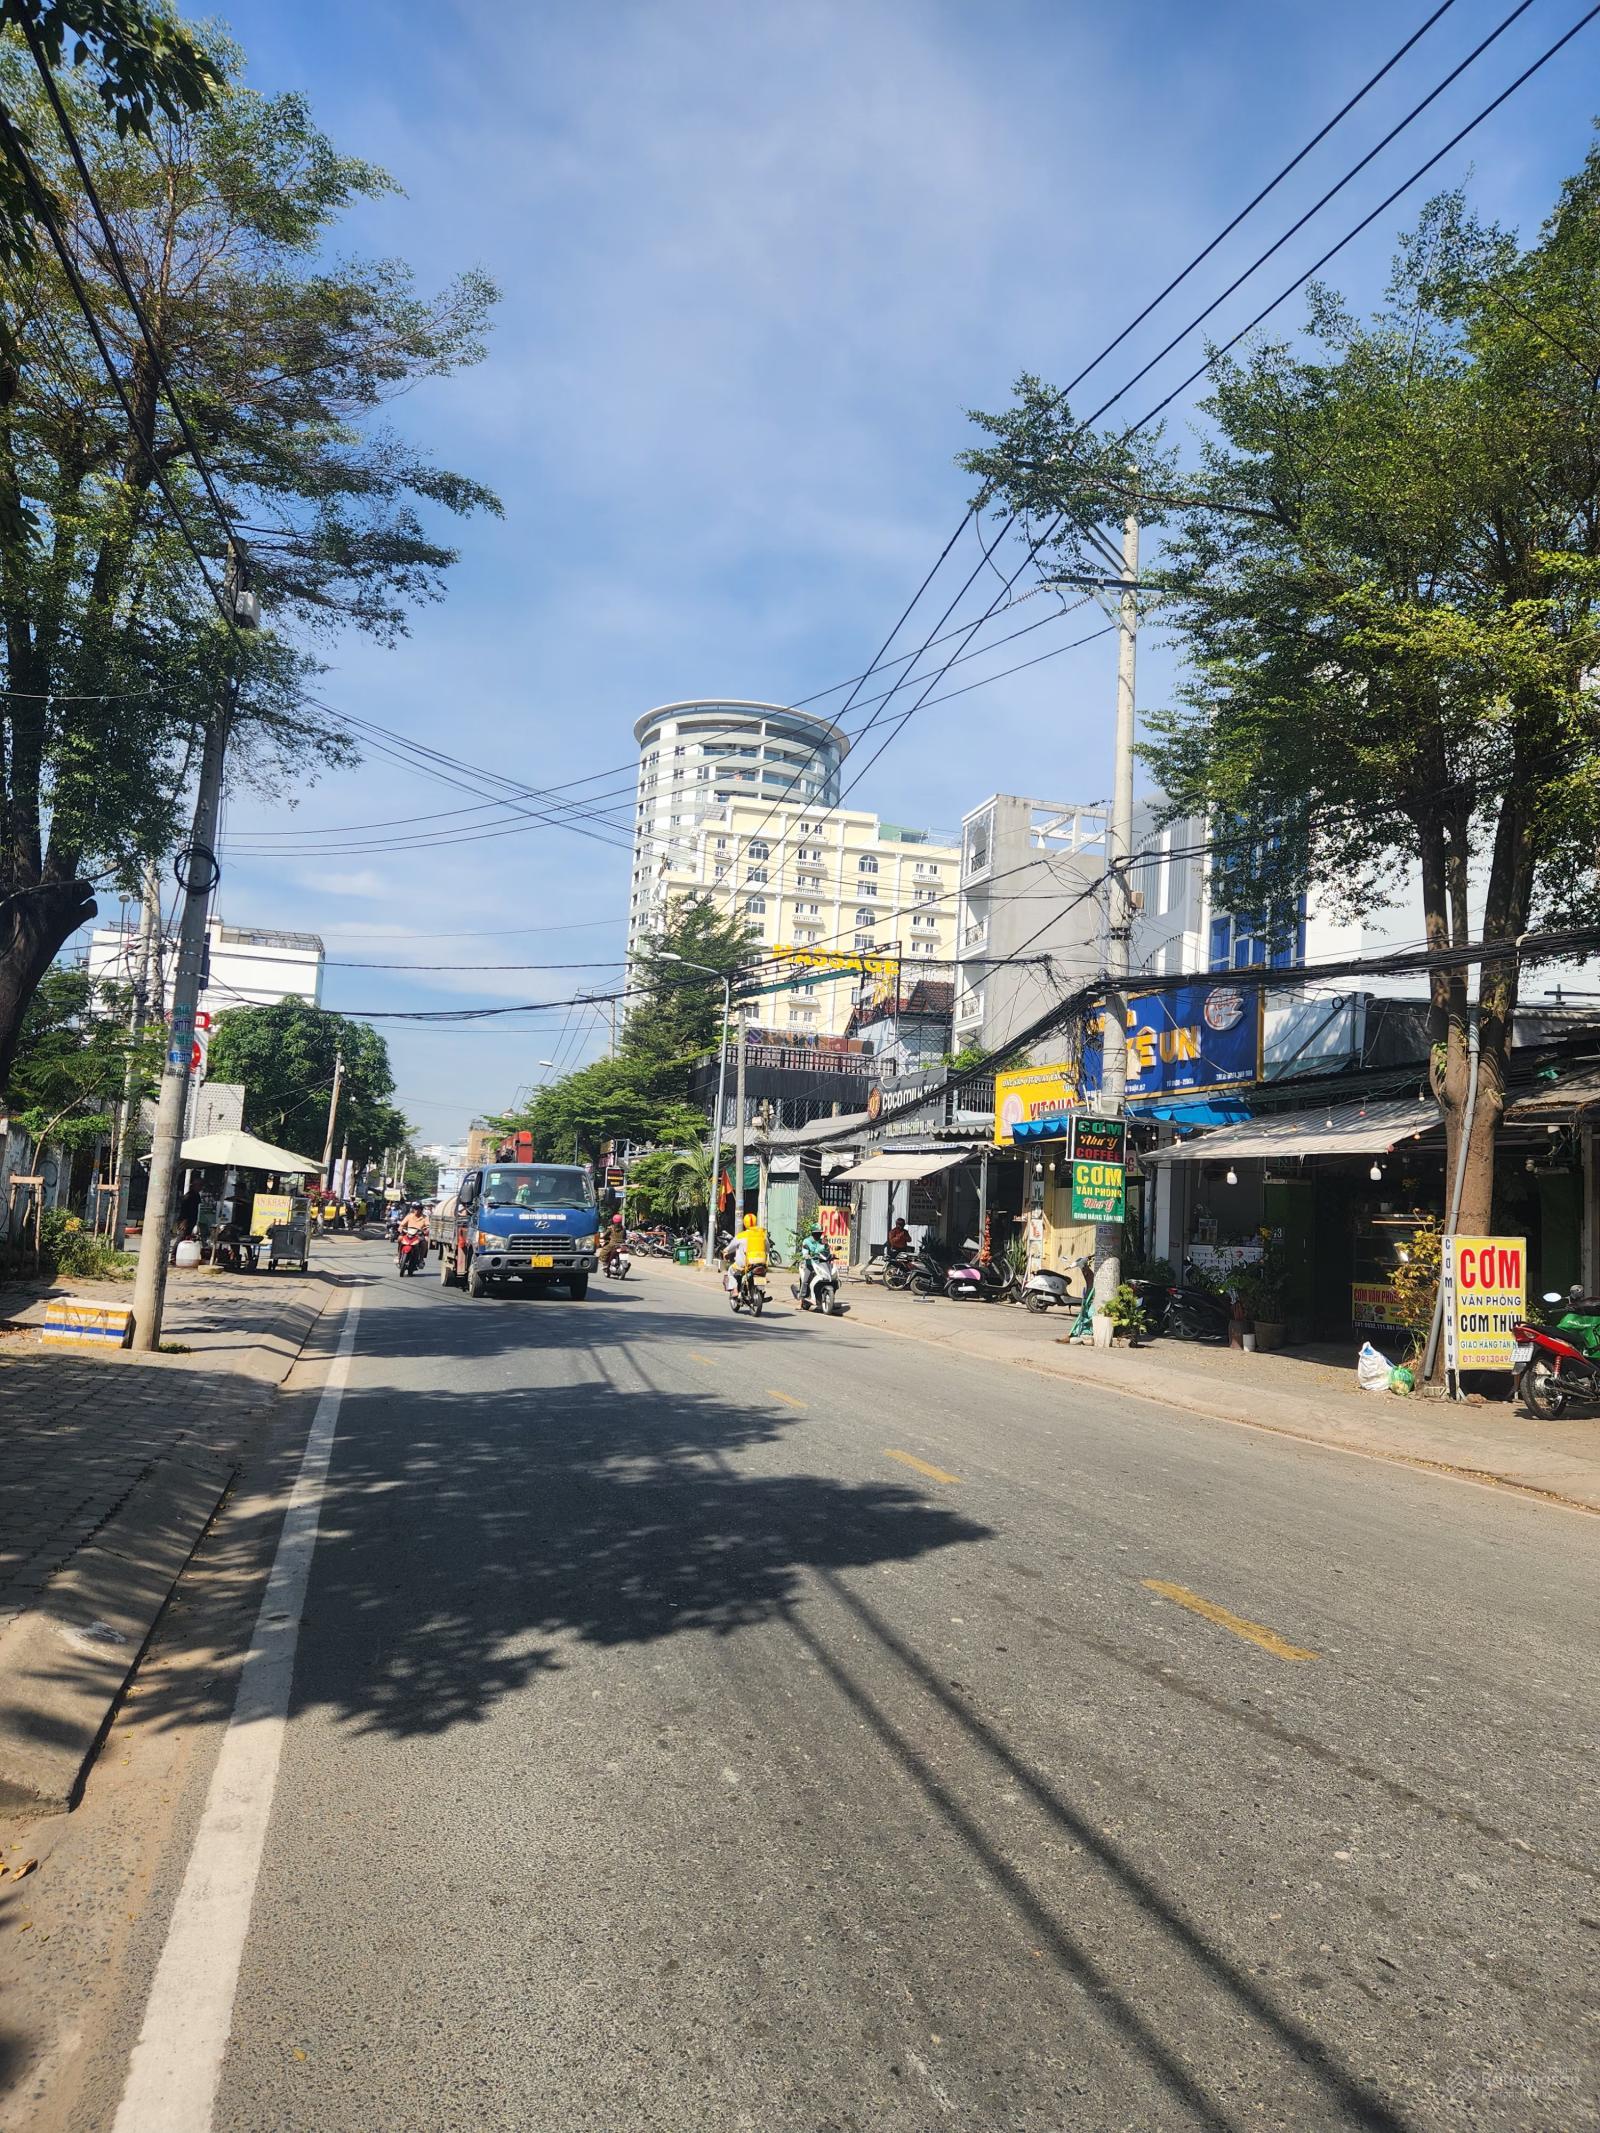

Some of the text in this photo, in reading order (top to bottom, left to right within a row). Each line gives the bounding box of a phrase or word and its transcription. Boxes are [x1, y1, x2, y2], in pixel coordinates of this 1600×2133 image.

[772, 944, 899, 974] MASSAGE
[1078, 1121, 1123, 1136] CƠM
[1076, 1148, 1120, 1162] COFFEE
[1076, 1165, 1122, 1187] CƠM
[1460, 1246, 1520, 1289] CƠM
[1461, 1293, 1521, 1306] VĂN PHÒNG
[1460, 1313, 1489, 1333] CƠM
[1460, 1341, 1477, 1349] GIAO
